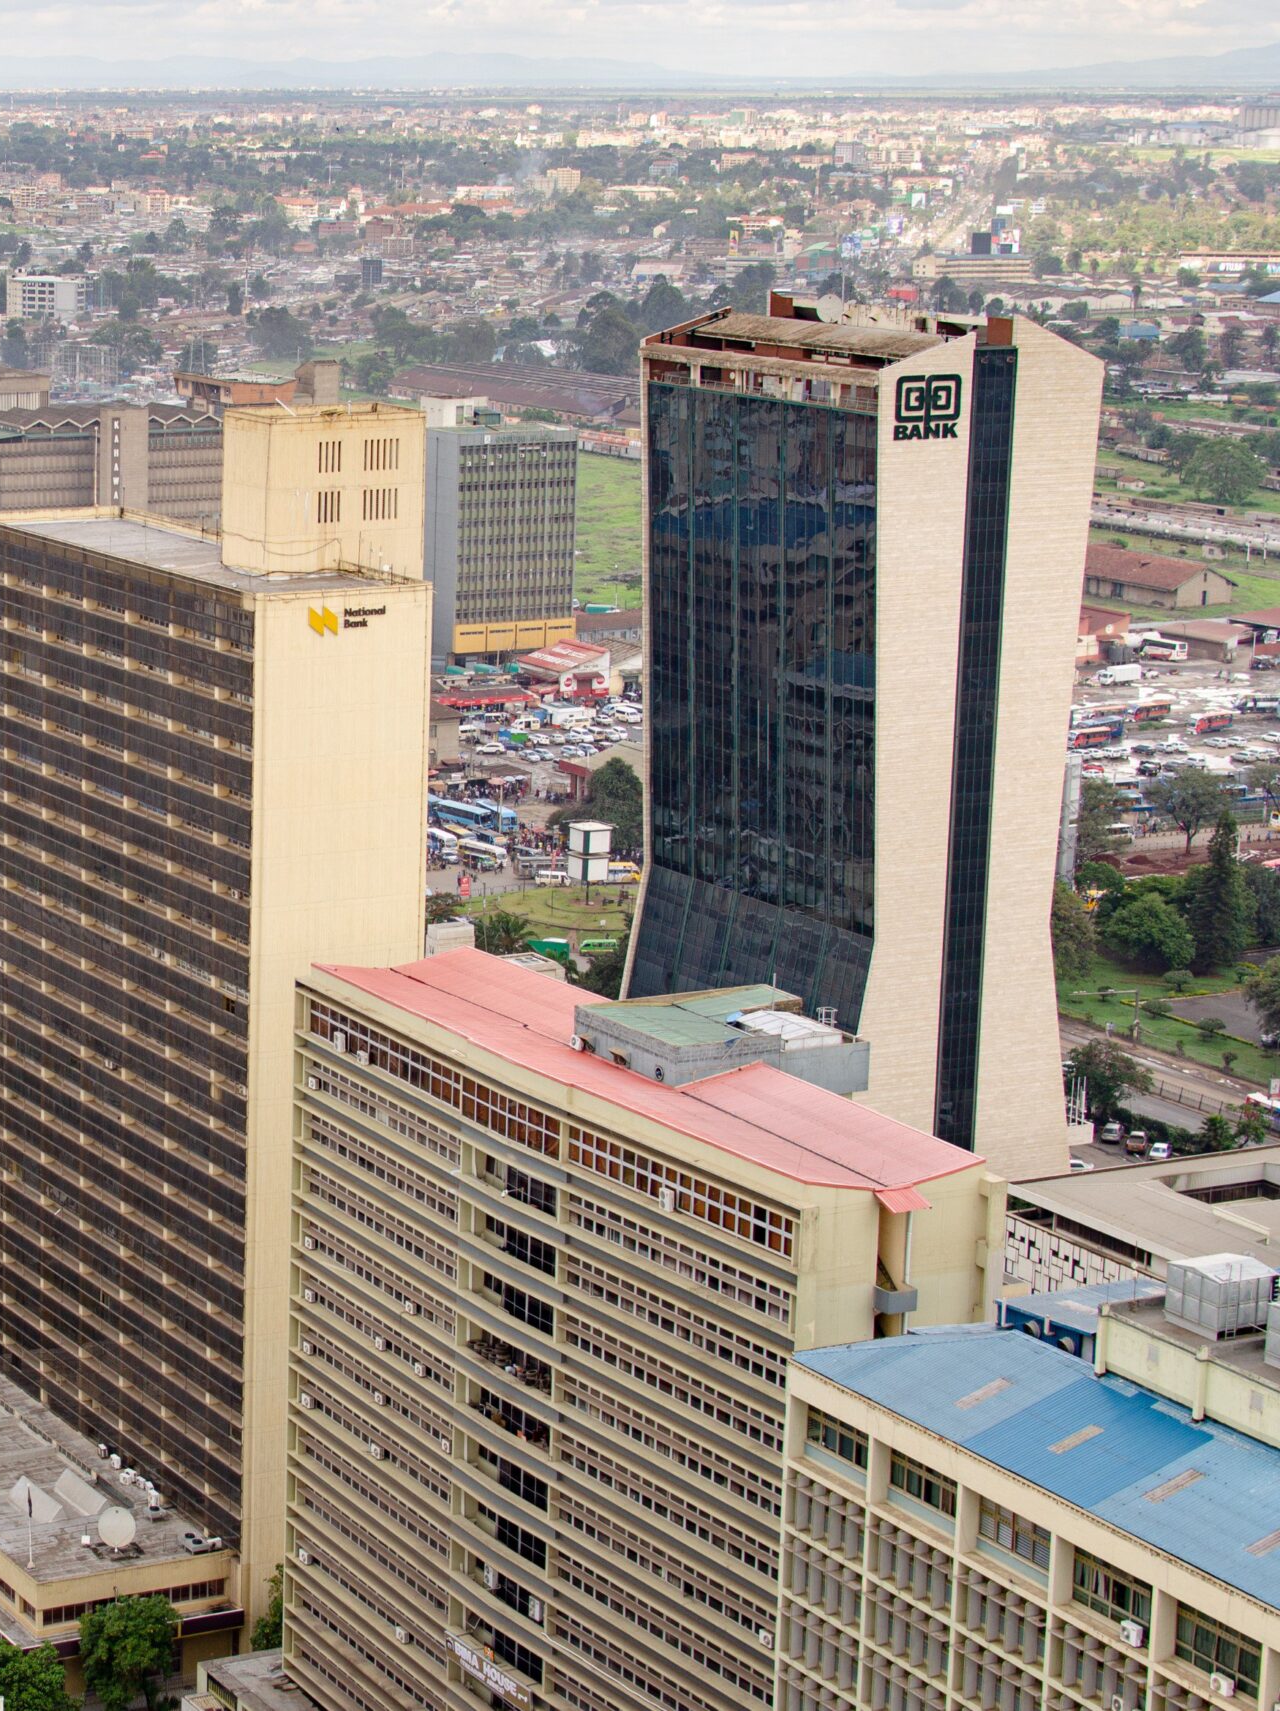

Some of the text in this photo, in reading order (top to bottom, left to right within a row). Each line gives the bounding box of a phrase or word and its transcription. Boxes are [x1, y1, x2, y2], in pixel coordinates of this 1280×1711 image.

[893, 423, 958, 440] BANK
[112, 420, 120, 500] KAHAWA
[344, 605, 386, 617] National
[344, 618, 368, 628] Bank
[454, 1641, 518, 1698] BIMA HOUSE
